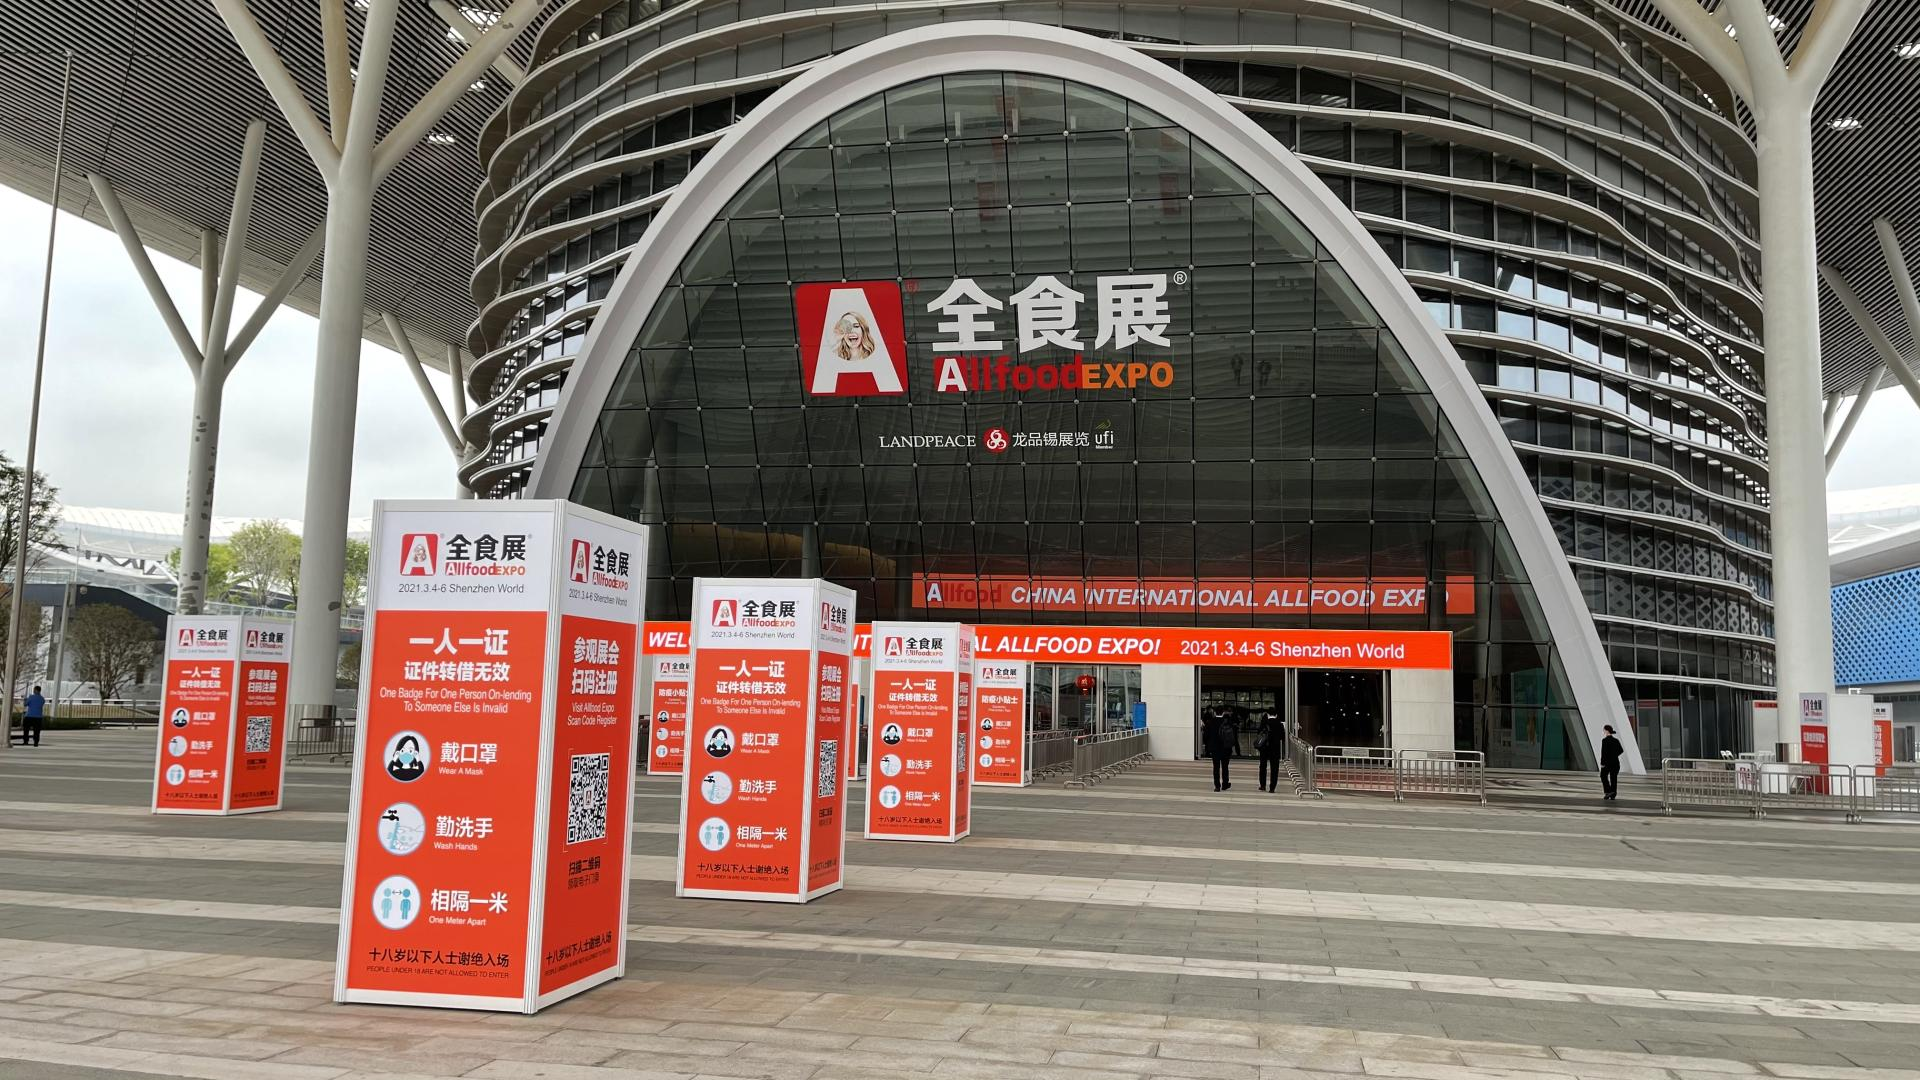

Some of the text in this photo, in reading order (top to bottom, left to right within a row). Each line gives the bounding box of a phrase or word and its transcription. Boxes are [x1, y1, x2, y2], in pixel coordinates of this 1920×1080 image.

[927, 274, 1171, 354] 全食展
[811, 288, 904, 394] A
[879, 435, 976, 448] LANDPEACE
[1012, 432, 1090, 447] 龙品锡展览
[1095, 431, 1114, 445] ufi
[446, 534, 526, 561] 全食展
[593, 545, 629, 577] 全食展
[398, 583, 524, 593] 2021.3.4-6 Shenzhen World
[927, 582, 1449, 607] Allfood CHINA INTERNATIONAL ALLFOOD EXP
[742, 600, 796, 618] 全食展
[197, 629, 228, 640] 全食展
[260, 631, 284, 643] 全食展
[409, 627, 509, 655] 一人一证
[574, 636, 620, 665] 参观展会
[649, 632, 691, 648] WEL
[997, 636, 1093, 653] ALLFOOD
[1097, 638, 1161, 655] EXPO!
[1180, 640, 1265, 656] 2021.3.4-6
[1270, 642, 1352, 658] Shenzhen
[1357, 643, 1405, 659] World
[906, 637, 943, 650] 全食展
[404, 661, 511, 682] 证件转借无效
[719, 659, 785, 678] 一人一证
[571, 668, 617, 695] 扫码注册
[716, 681, 786, 694] 证件转借无效
[890, 678, 937, 690] 一人一证
[380, 687, 532, 703] One Badge For One Person On-lending
[700, 697, 711, 705] One
[403, 701, 509, 713] To Someone Else Is Invalid
[741, 732, 779, 746] 戴口罩
[440, 741, 497, 764] 戴口罩
[438, 767, 484, 776] Wear A Mask
[738, 779, 776, 794] 勤洗手
[435, 816, 493, 838] 勤洗手
[736, 826, 787, 841] 相隔一米
[434, 842, 478, 851] Wash Hands
[697, 863, 789, 875] 十八岁以下人士谢绝入场
[431, 889, 509, 914] 相隔一米
[429, 916, 486, 926] One Meter Apart
[369, 948, 509, 967] 十八岁以下人士谢绝入场
[366, 966, 390, 974] PEOPLE
